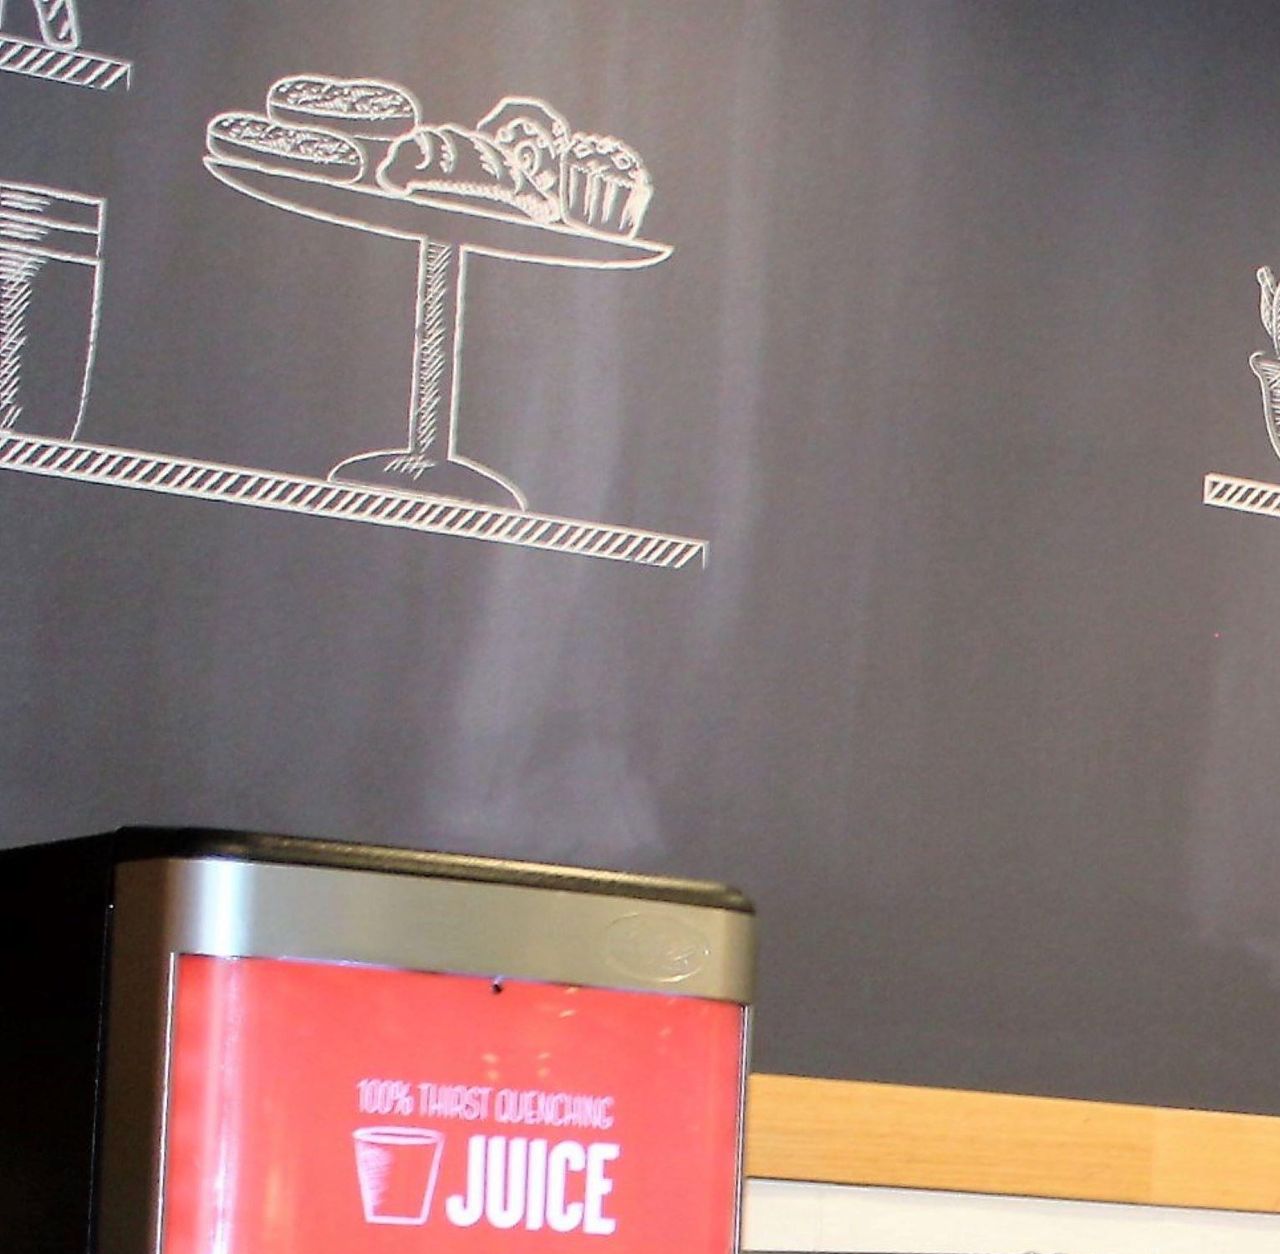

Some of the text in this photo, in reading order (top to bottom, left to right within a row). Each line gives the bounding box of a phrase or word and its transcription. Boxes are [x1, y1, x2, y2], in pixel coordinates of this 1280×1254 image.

[356, 1078, 615, 1130] 100% THIRST QUENCHING
[445, 1132, 622, 1236] JUICE
